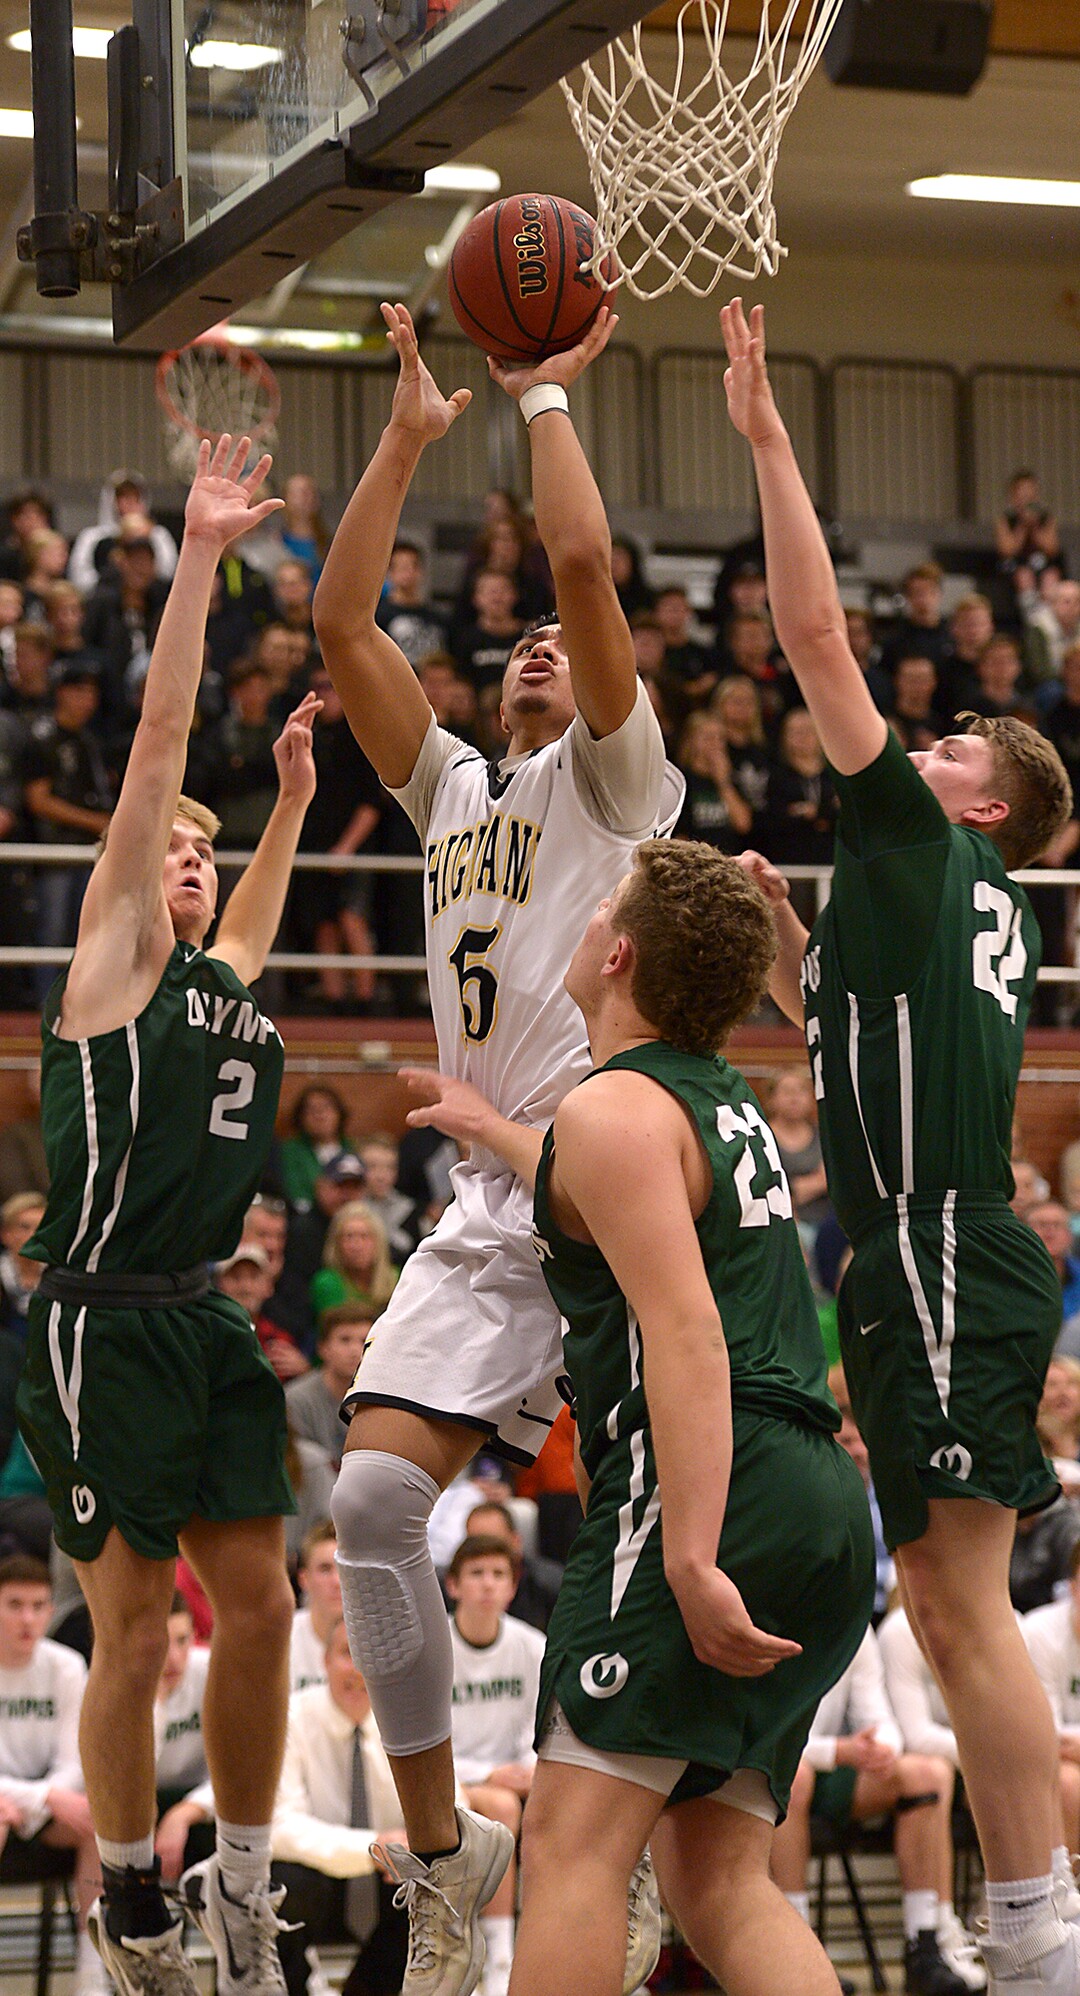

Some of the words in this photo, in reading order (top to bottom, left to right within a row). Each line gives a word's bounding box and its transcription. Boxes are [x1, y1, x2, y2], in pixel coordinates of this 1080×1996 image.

[513, 197, 549, 299] Wilson
[448, 921, 503, 1047] 5
[208, 1058, 257, 1140] 2
[715, 1102, 793, 1228] 23
